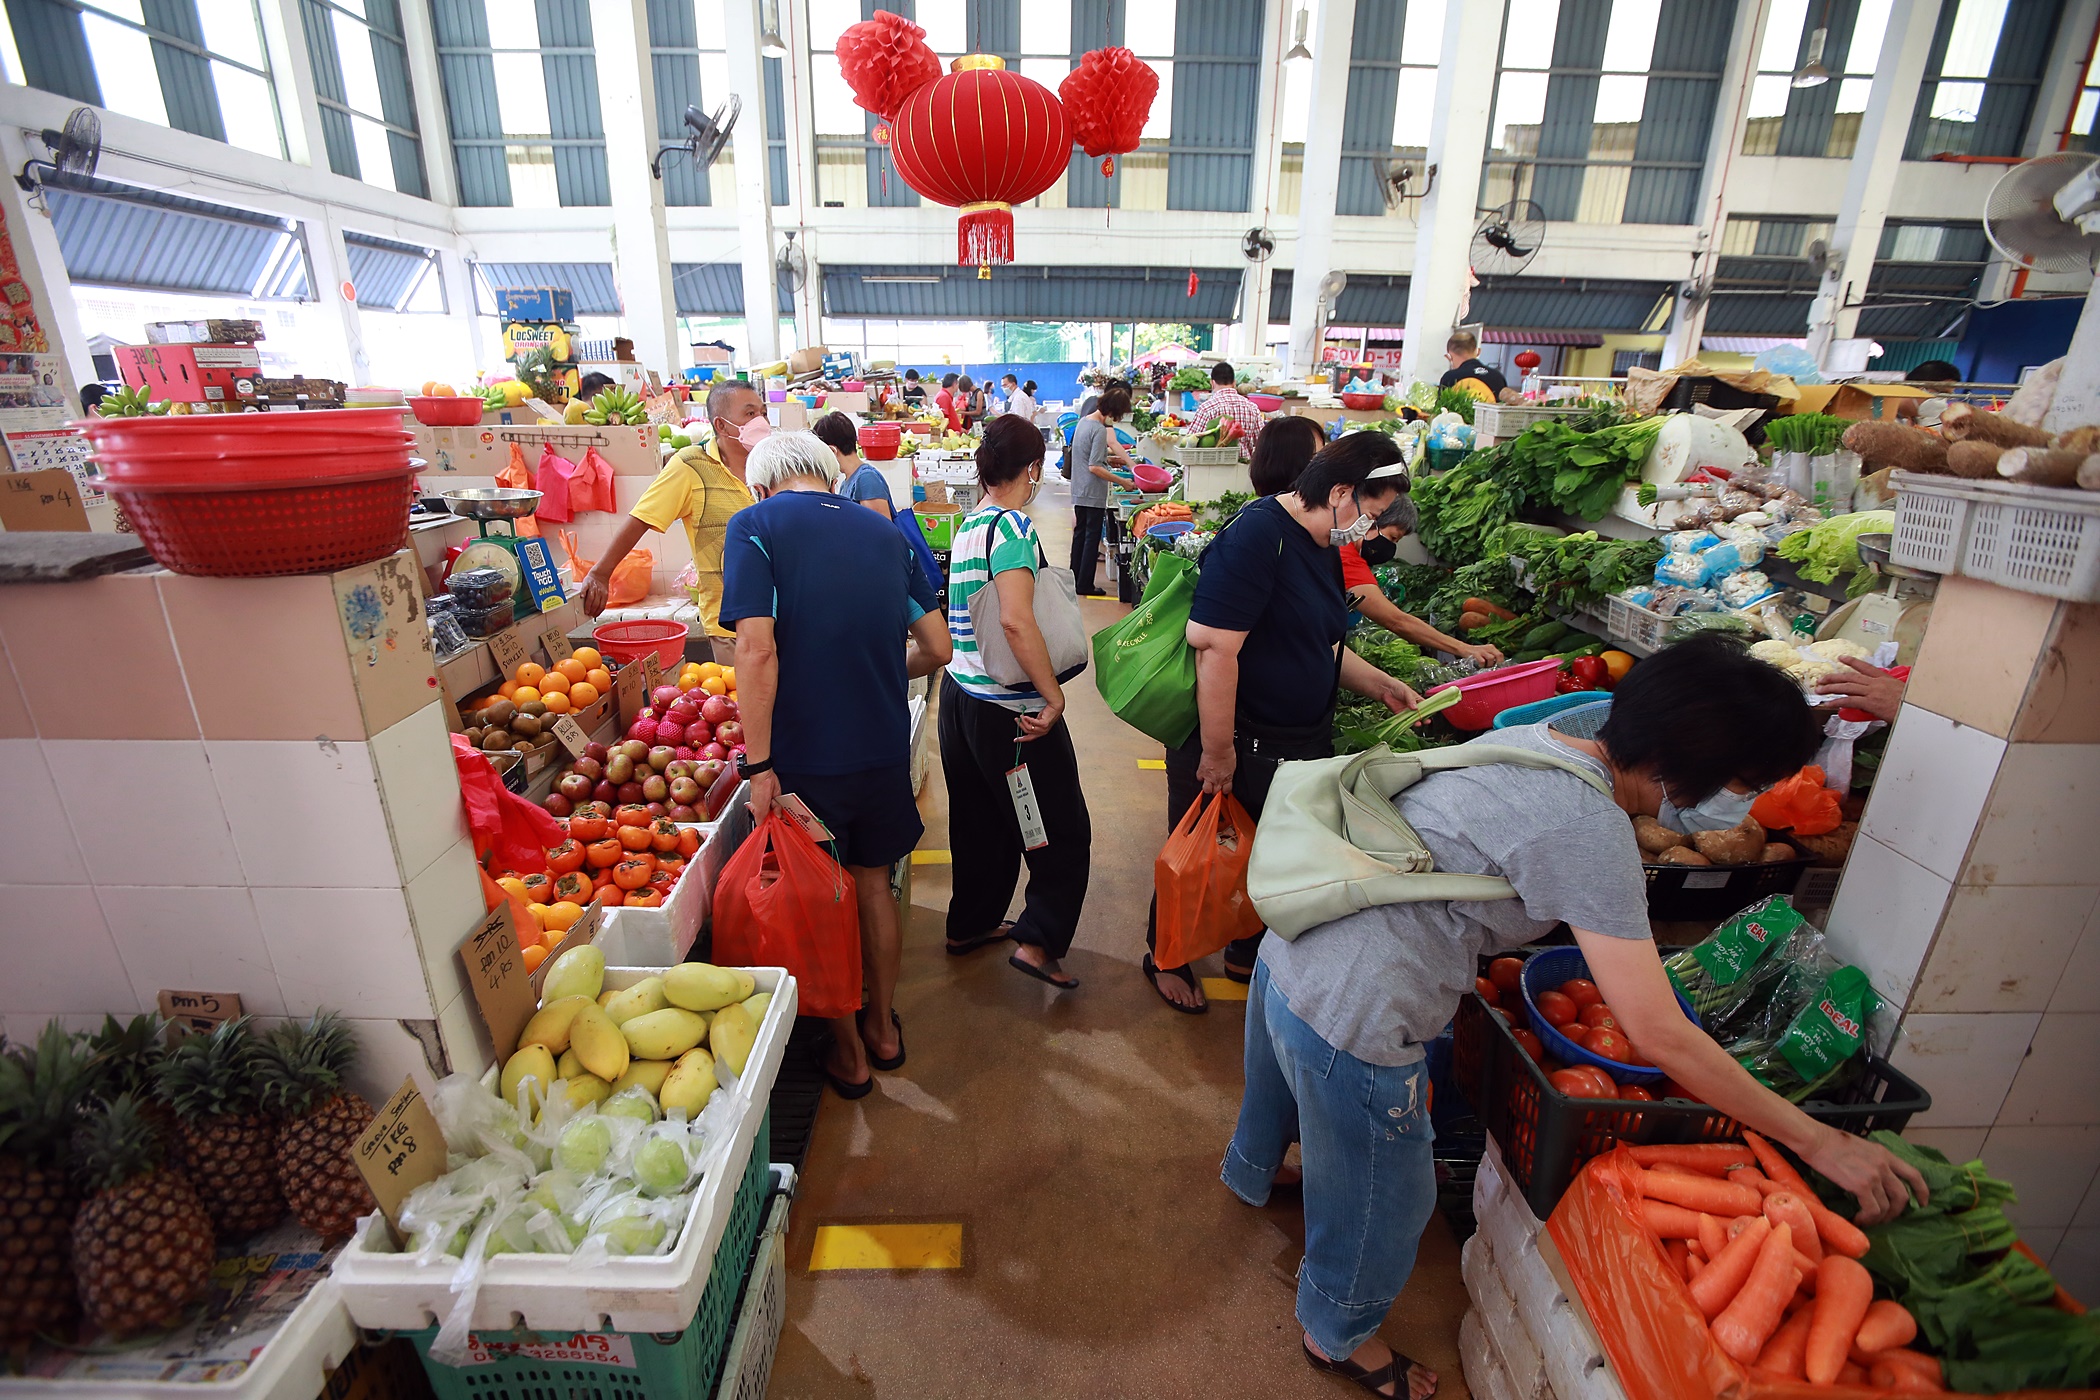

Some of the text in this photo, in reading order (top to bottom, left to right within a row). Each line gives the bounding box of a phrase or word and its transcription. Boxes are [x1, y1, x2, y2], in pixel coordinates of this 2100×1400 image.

[1323, 346, 1402, 364] COVD-19
[57, 488, 72, 507] 4
[532, 568, 551, 580] Touch
[538, 584, 557, 596] eWallet
[495, 934, 510, 953] 10
[1728, 947, 1740, 959] HK
[1726, 957, 1741, 973] SUM
[490, 973, 501, 989] 4
[201, 995, 220, 1013] 5
[1819, 1000, 1860, 1039] IDEAL
[1812, 1032, 1823, 1046] HK
[1814, 1046, 1828, 1063] SUM
[390, 1121, 409, 1144] KG
[402, 1136, 417, 1154] 8
